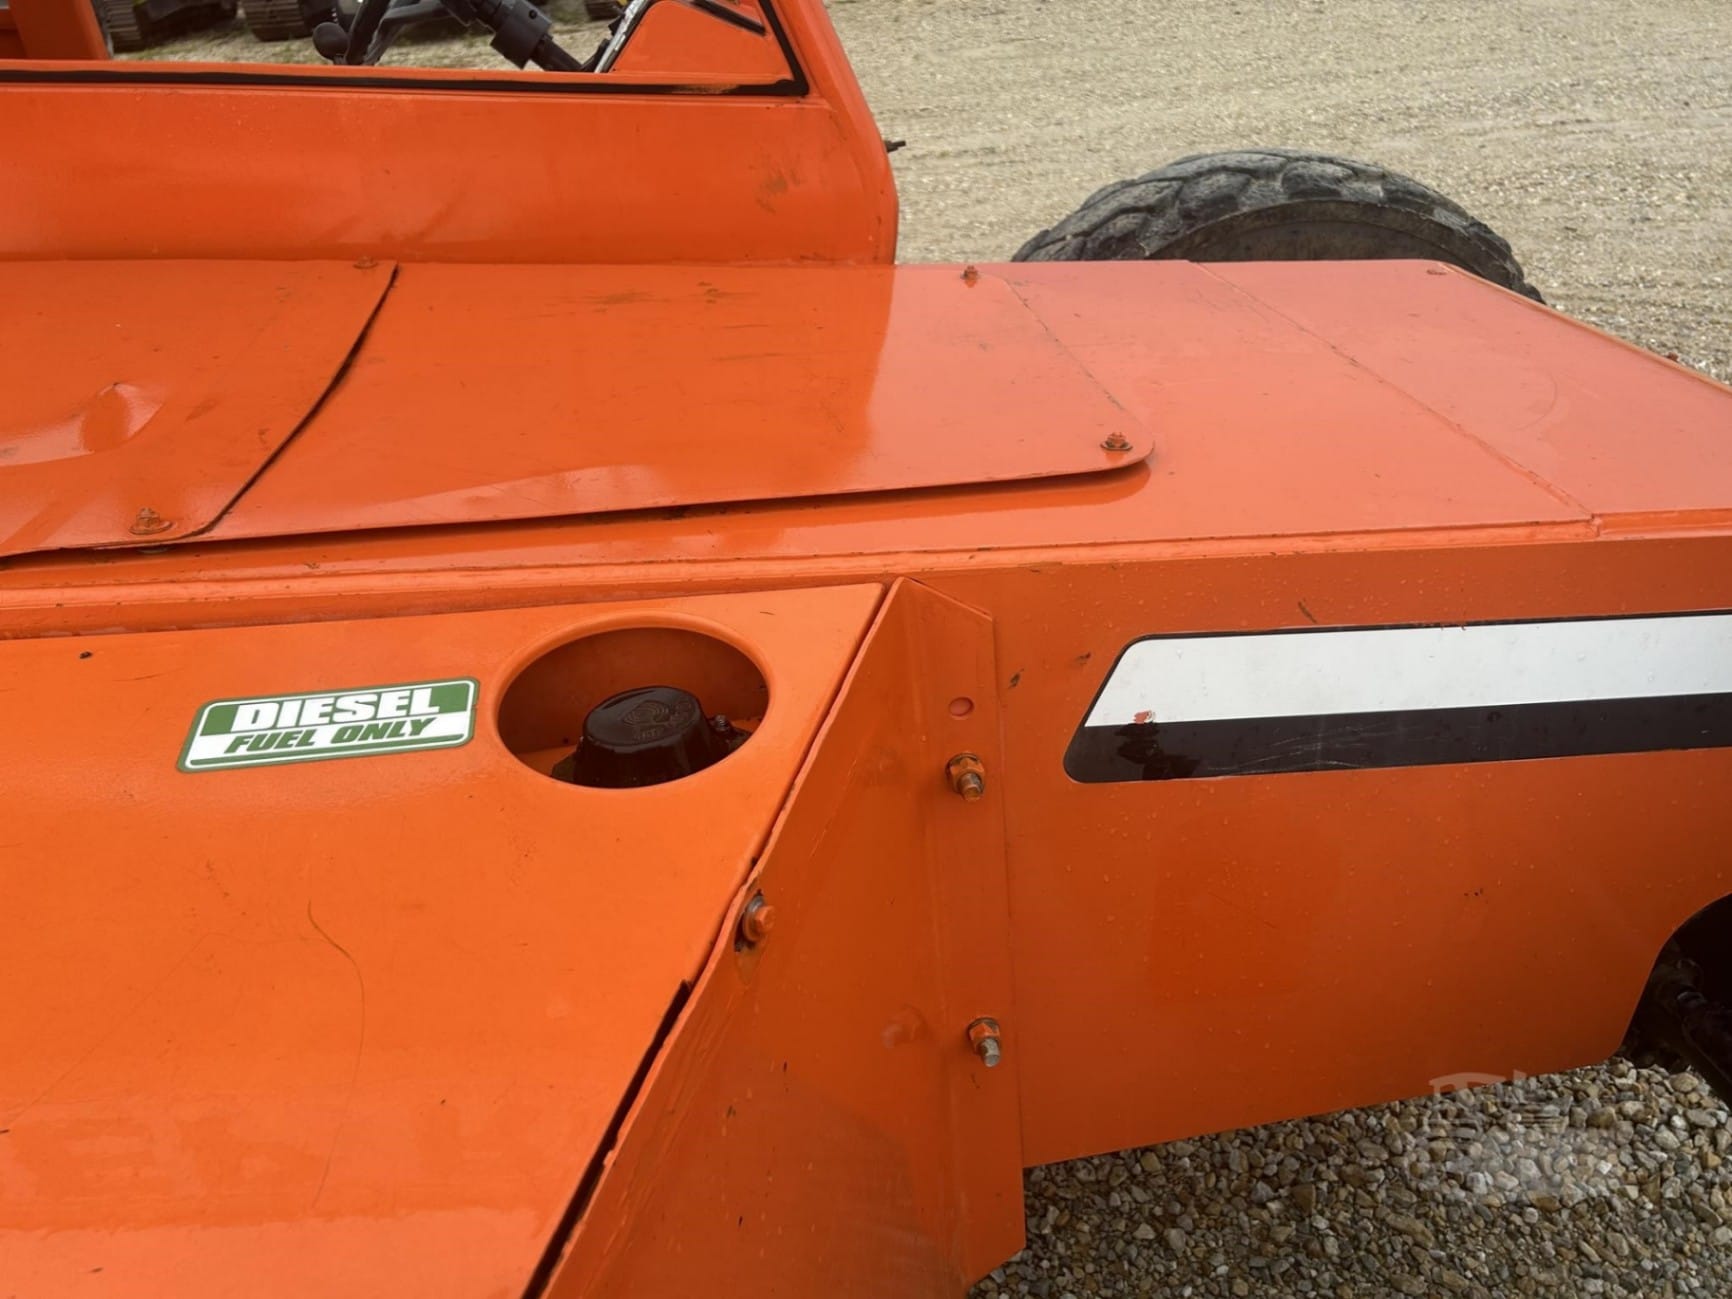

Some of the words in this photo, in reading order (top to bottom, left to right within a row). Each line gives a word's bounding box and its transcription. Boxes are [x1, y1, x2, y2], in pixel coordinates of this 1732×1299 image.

[230, 687, 440, 732] DIESEL
[223, 728, 317, 754] FUEL
[330, 717, 438, 744] ONLY
